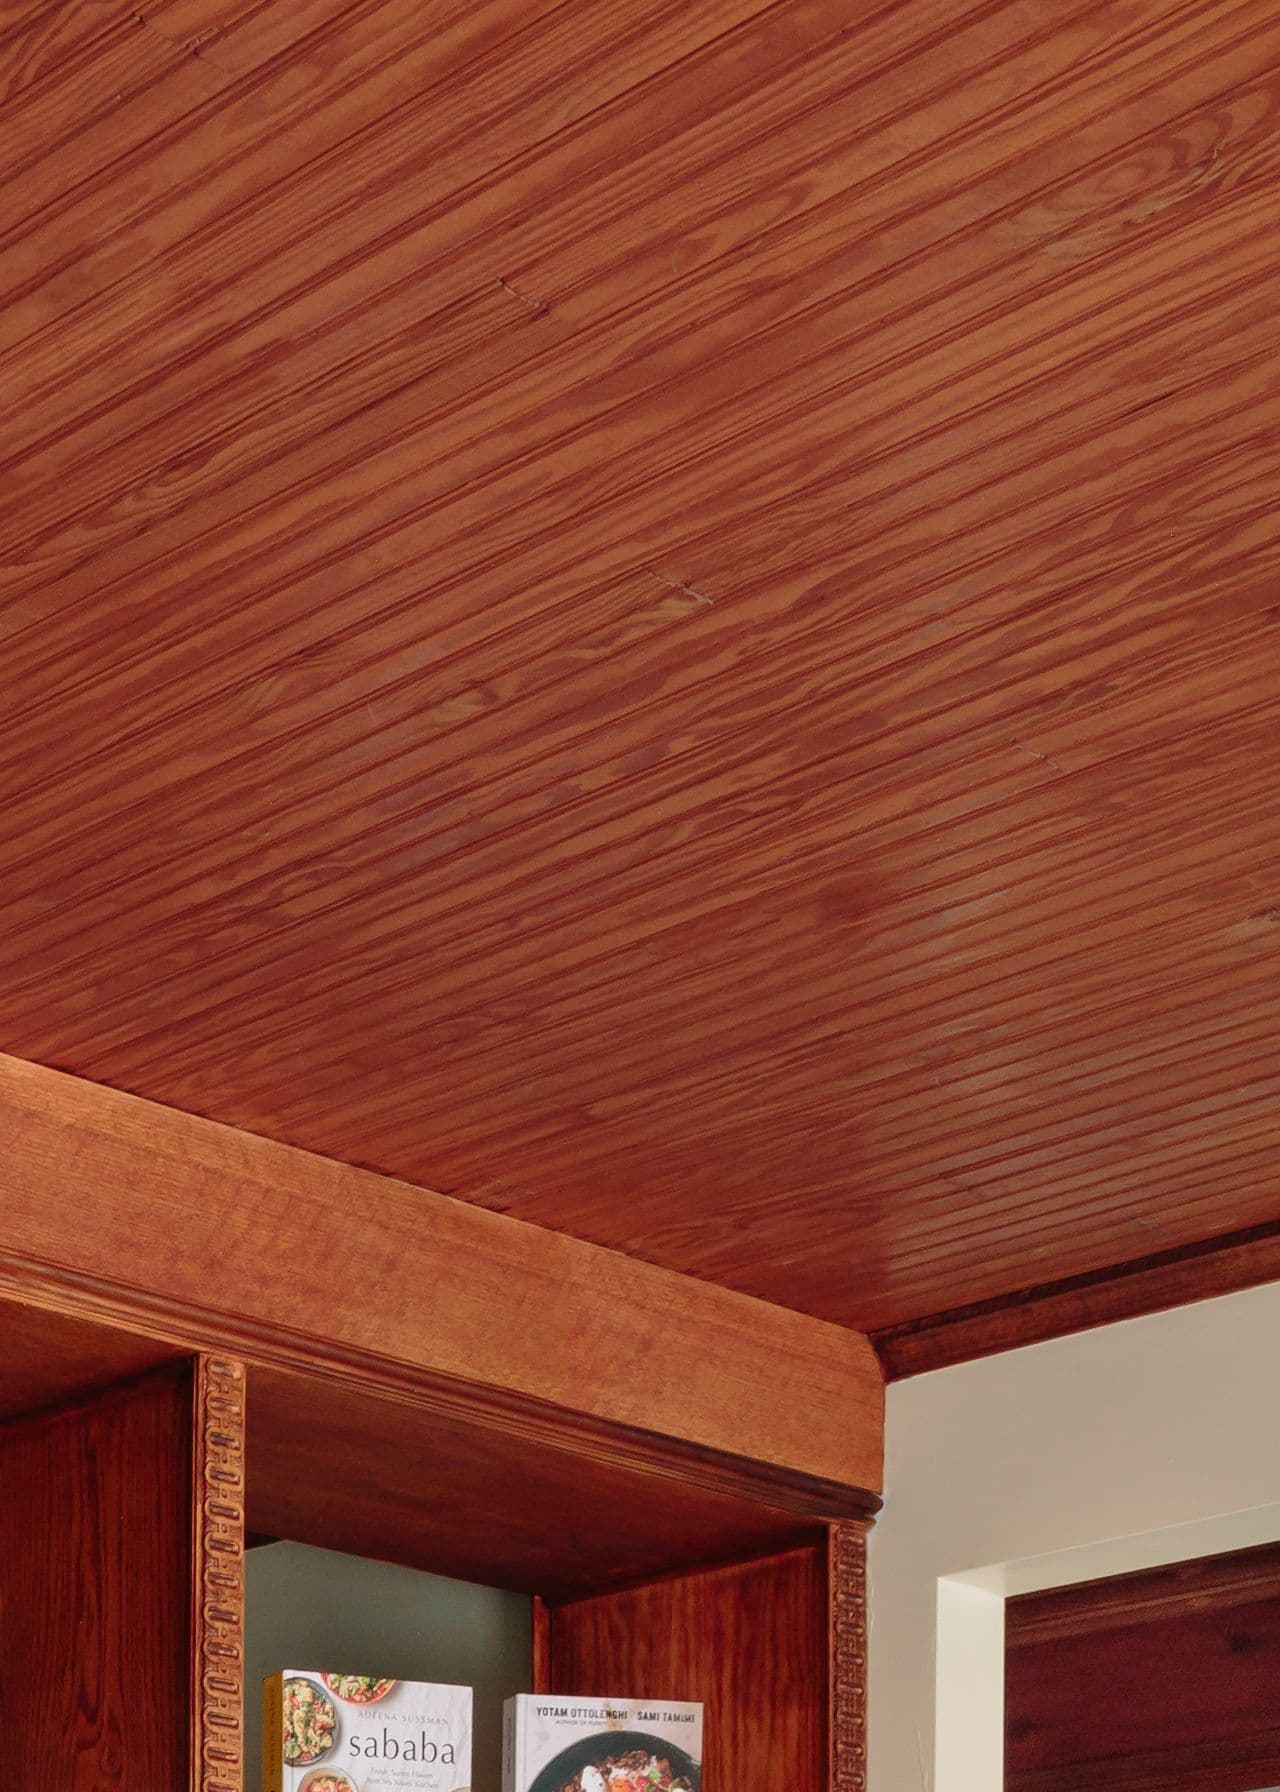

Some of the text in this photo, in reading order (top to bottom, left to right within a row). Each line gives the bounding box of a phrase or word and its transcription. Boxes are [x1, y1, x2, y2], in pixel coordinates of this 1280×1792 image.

[537, 1707, 695, 1723] YOTAM OTTOLENGHI SAMI TAMIMI
[349, 1728, 455, 1764] sababa
